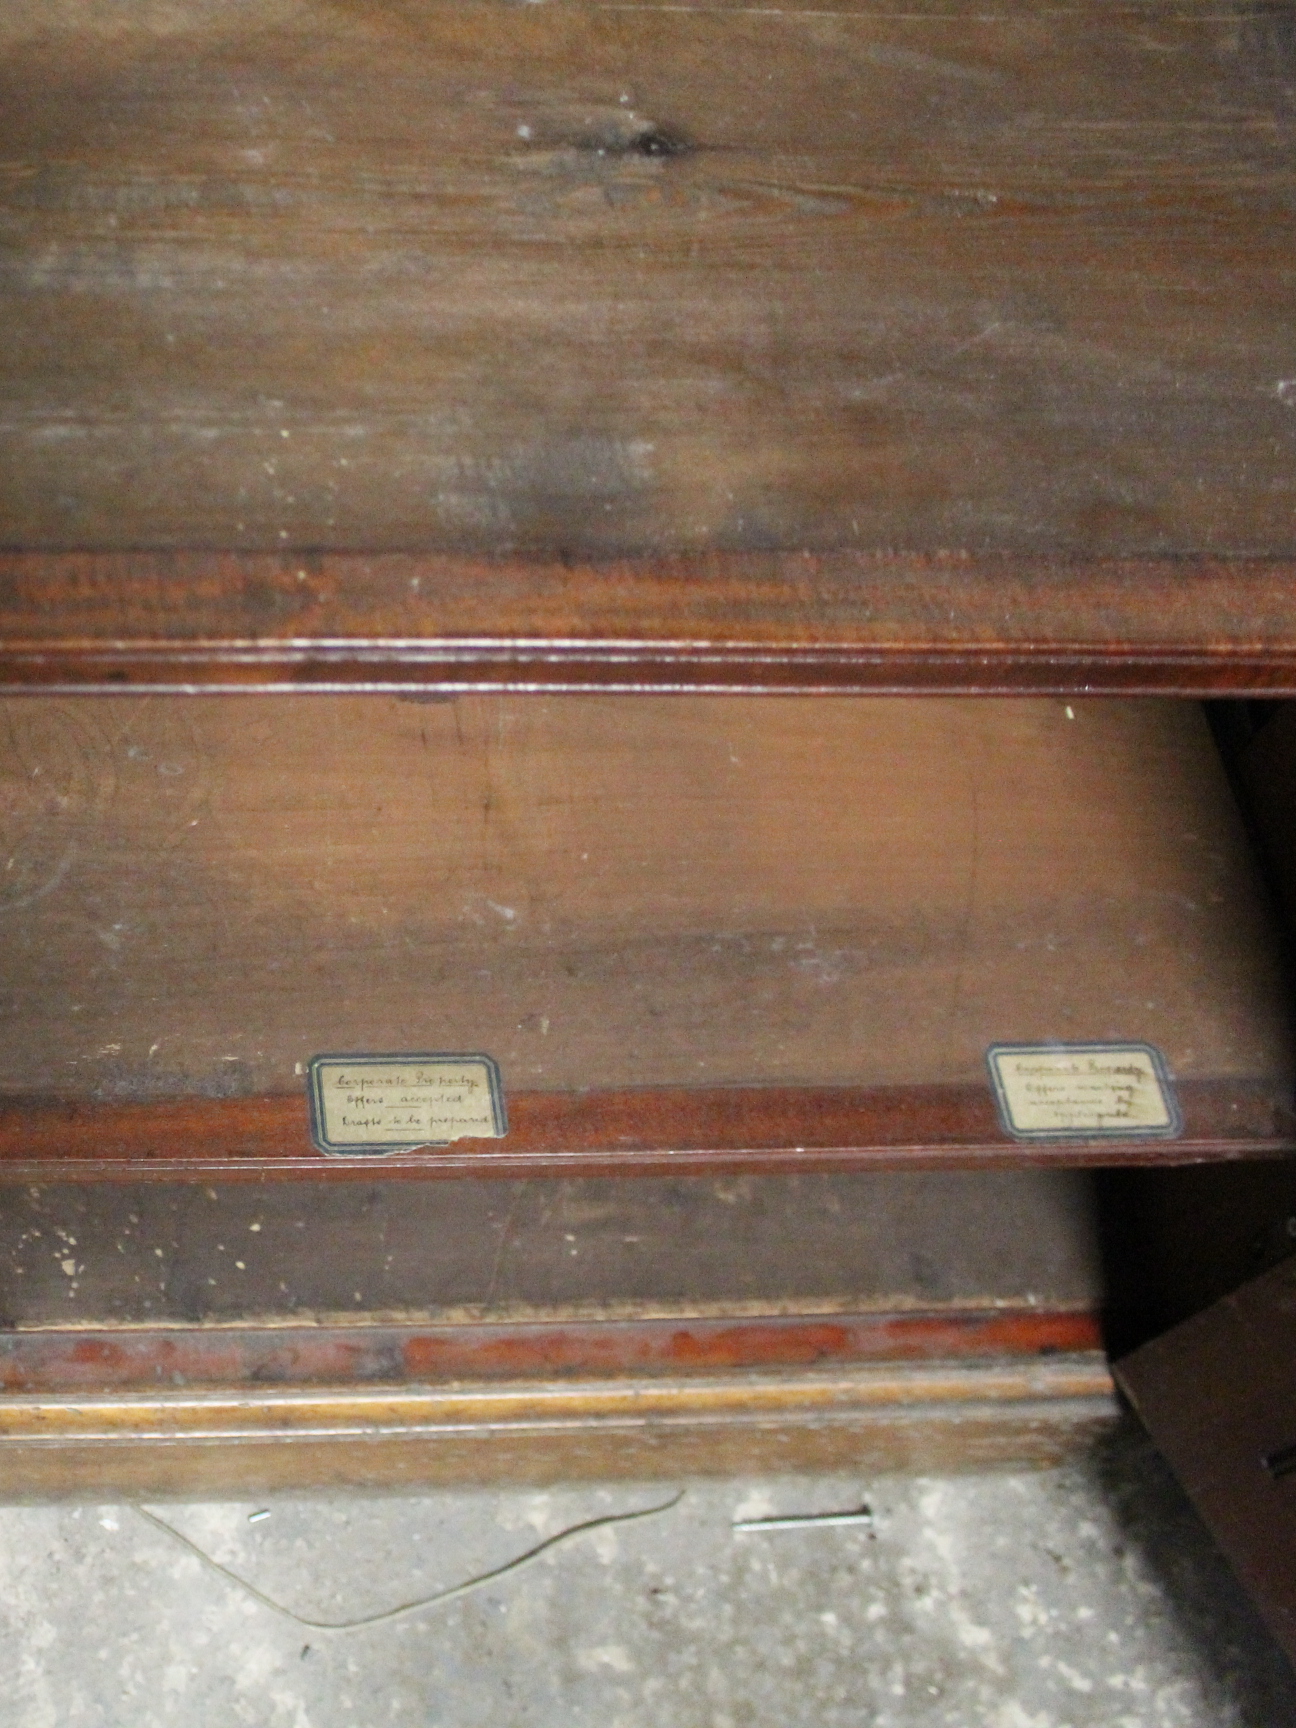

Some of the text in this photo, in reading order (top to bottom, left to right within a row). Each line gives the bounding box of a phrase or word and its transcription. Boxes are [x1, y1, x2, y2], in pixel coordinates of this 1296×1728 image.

[336, 1070, 479, 1094] Corporate Property
[346, 1093, 464, 1109] Offers accepted
[341, 1114, 382, 1130] Drafts
[405, 1113, 422, 1126] be
[429, 1114, 489, 1129] prepared
